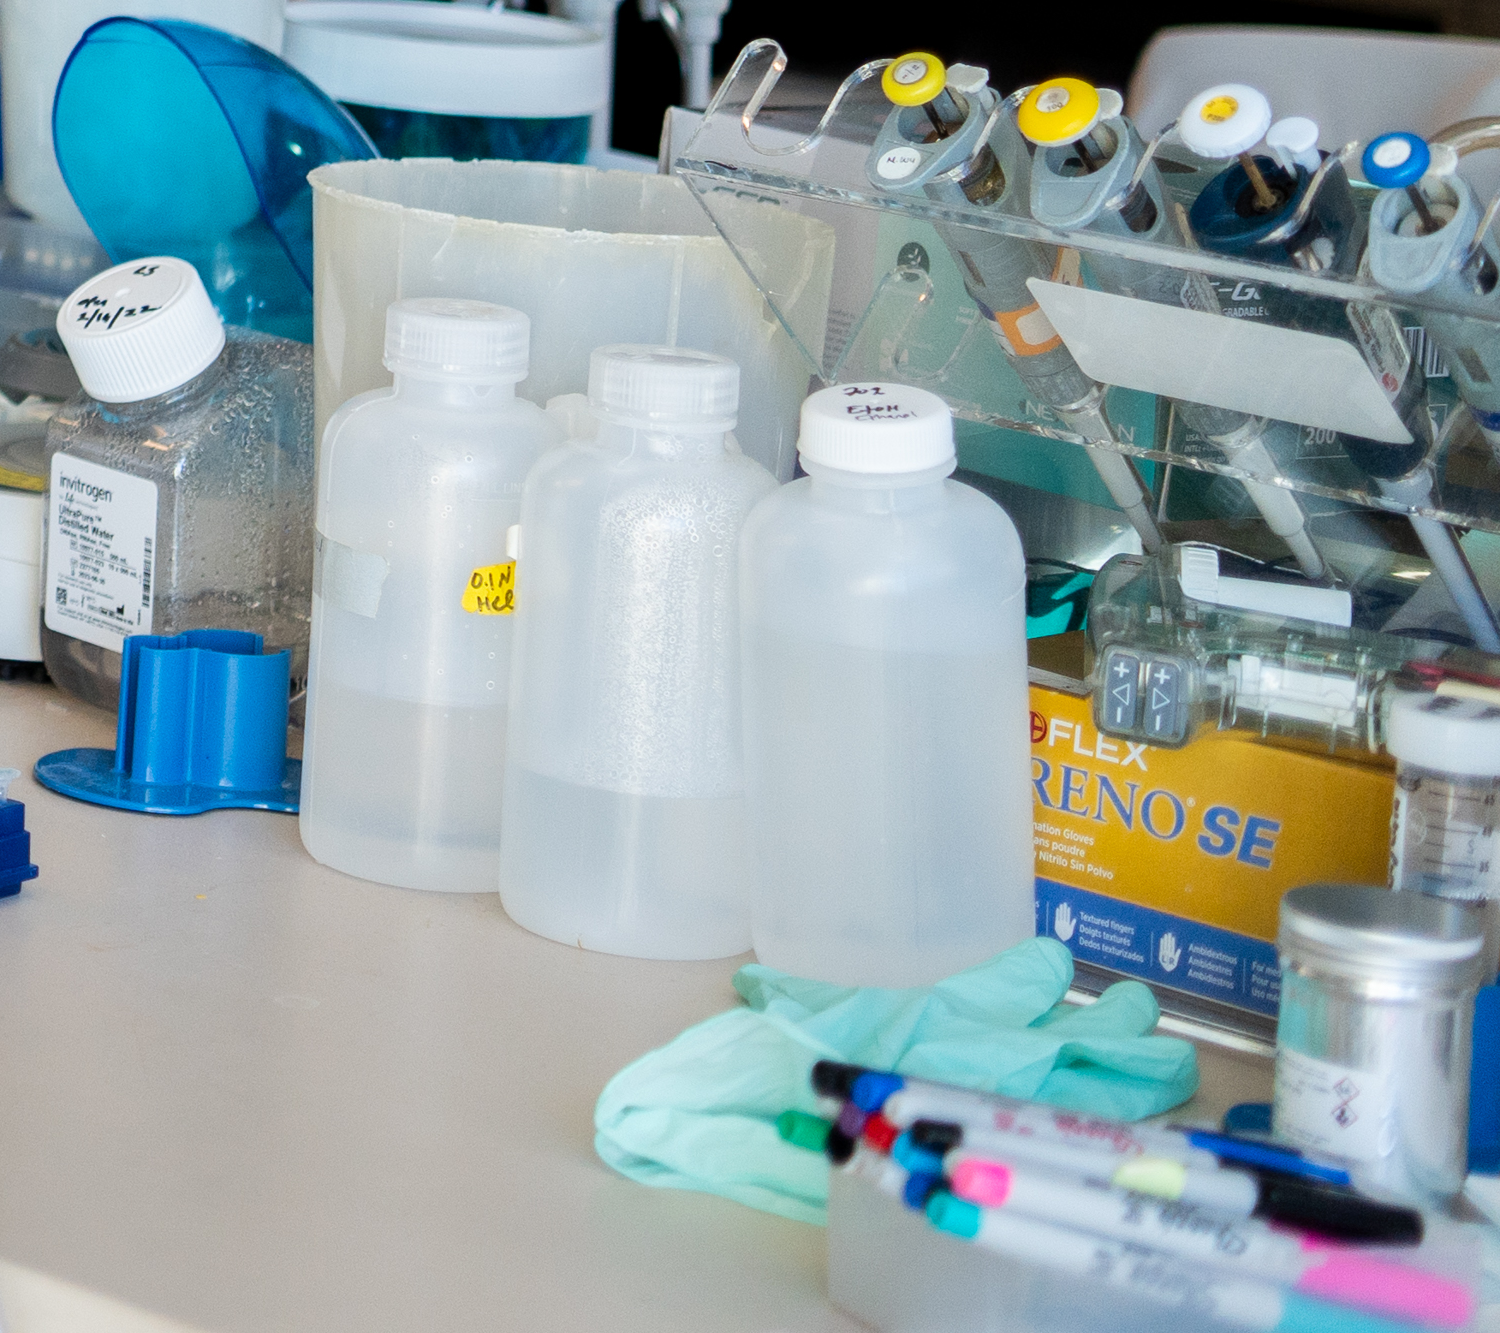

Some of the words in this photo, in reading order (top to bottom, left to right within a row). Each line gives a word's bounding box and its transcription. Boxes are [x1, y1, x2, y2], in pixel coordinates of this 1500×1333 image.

[1304, 427, 1337, 445] 200
[59, 471, 113, 503] invitrogen
[58, 515, 89, 533] Distilled
[91, 527, 114, 542] Water
[477, 589, 514, 612] HCl
[1048, 717, 1148, 772] FLEX
[1063, 828, 1095, 847] Gloves
[1197, 806, 1281, 870] SE
[1052, 841, 1086, 858] poudre
[1039, 851, 1068, 867] Nitrilo
[1070, 859, 1085, 872] Sin
[1087, 863, 1114, 880] Polvo
[1079, 911, 1110, 928] Textured
[1110, 919, 1135, 935] fingers
[1079, 924, 1102, 938] Doigts
[1078, 936, 1100, 951] Dedos
[1101, 942, 1144, 963] texturizados
[1188, 943, 1238, 965] Ambidextrous
[1188, 956, 1233, 976] Ambidextres
[1187, 968, 1235, 990] Ambidiestros
